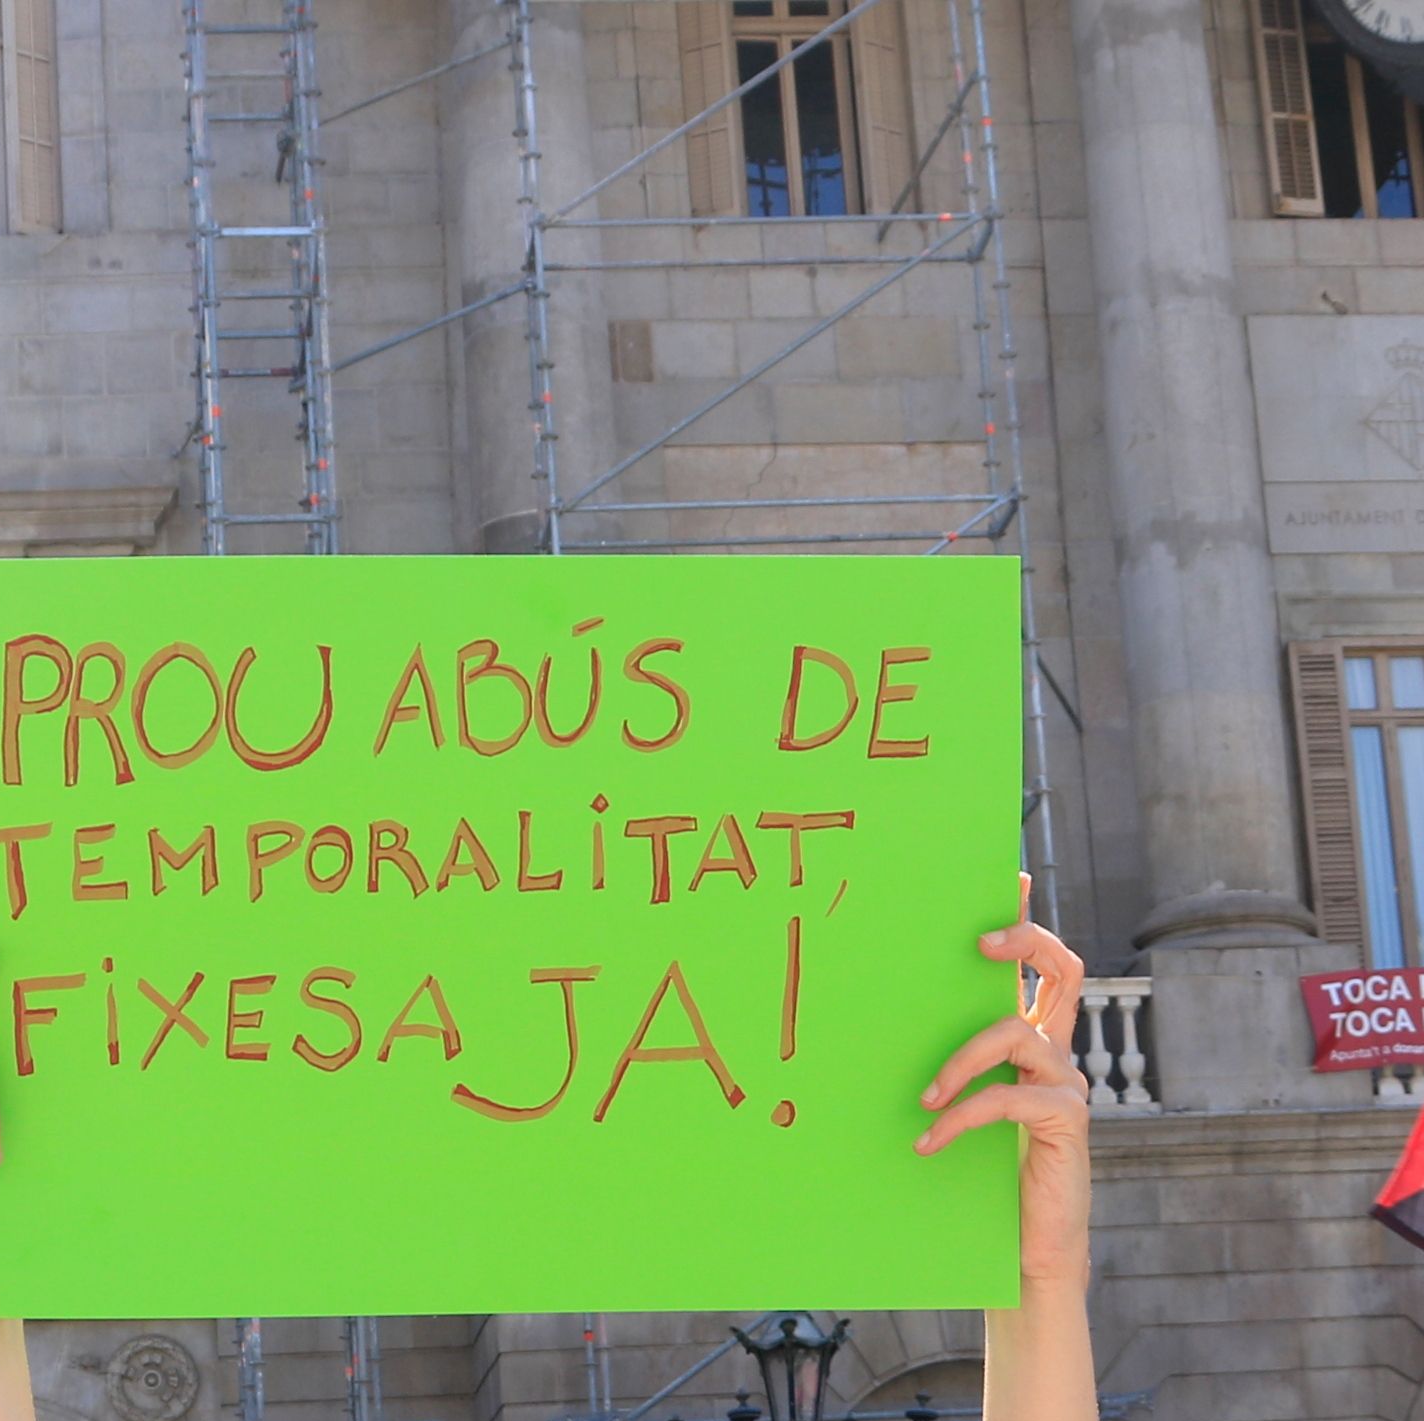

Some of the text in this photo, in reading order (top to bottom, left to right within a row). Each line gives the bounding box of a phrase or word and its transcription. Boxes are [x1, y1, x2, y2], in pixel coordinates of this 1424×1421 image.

[1284, 509, 1405, 526] AJUNTAMENT
[2, 618, 930, 786] PROU ABÚS DE
[1321, 975, 1412, 1007] TOCA
[452, 917, 801, 1128] JA!
[1329, 1006, 1417, 1038] TOCA
